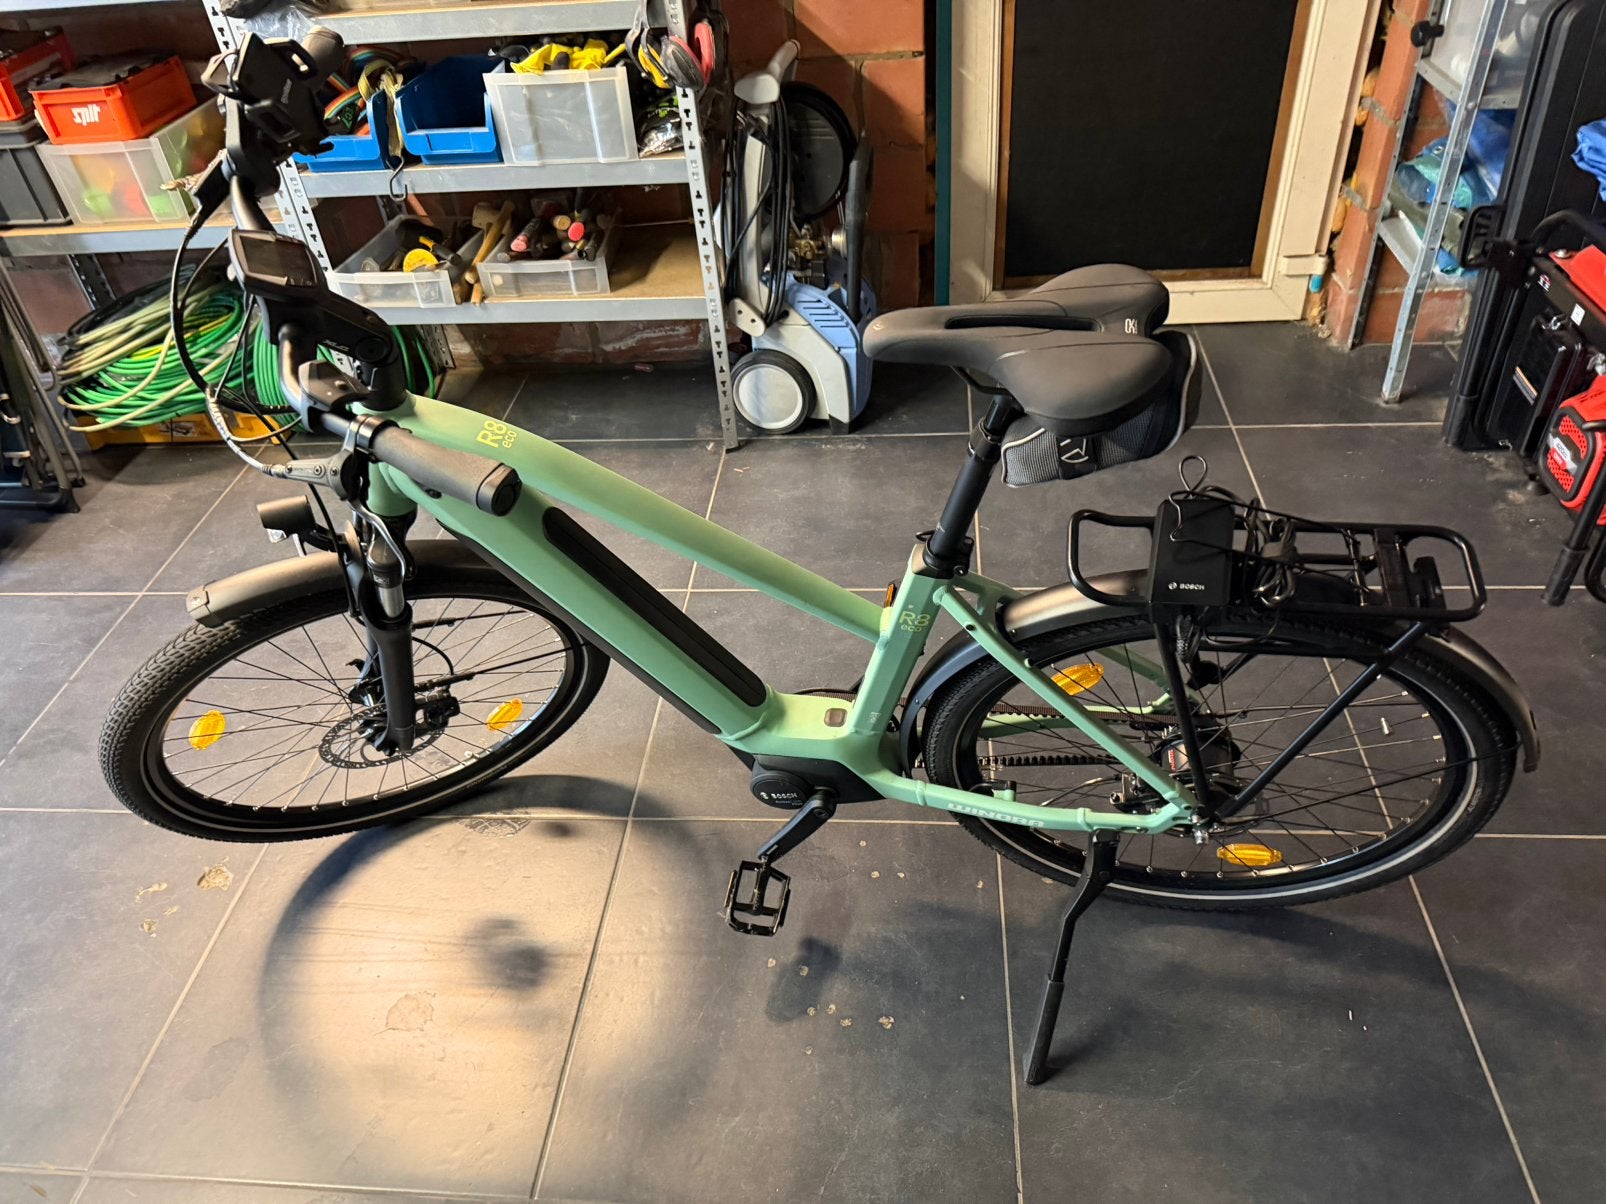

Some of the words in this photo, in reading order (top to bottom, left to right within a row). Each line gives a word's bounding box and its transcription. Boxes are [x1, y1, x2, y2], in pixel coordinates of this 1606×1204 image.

[475, 420, 507, 448] R8
[502, 430, 517, 448] eco
[898, 610, 931, 627] R8
[900, 624, 922, 632] eco
[947, 802, 1046, 828] WINORA
